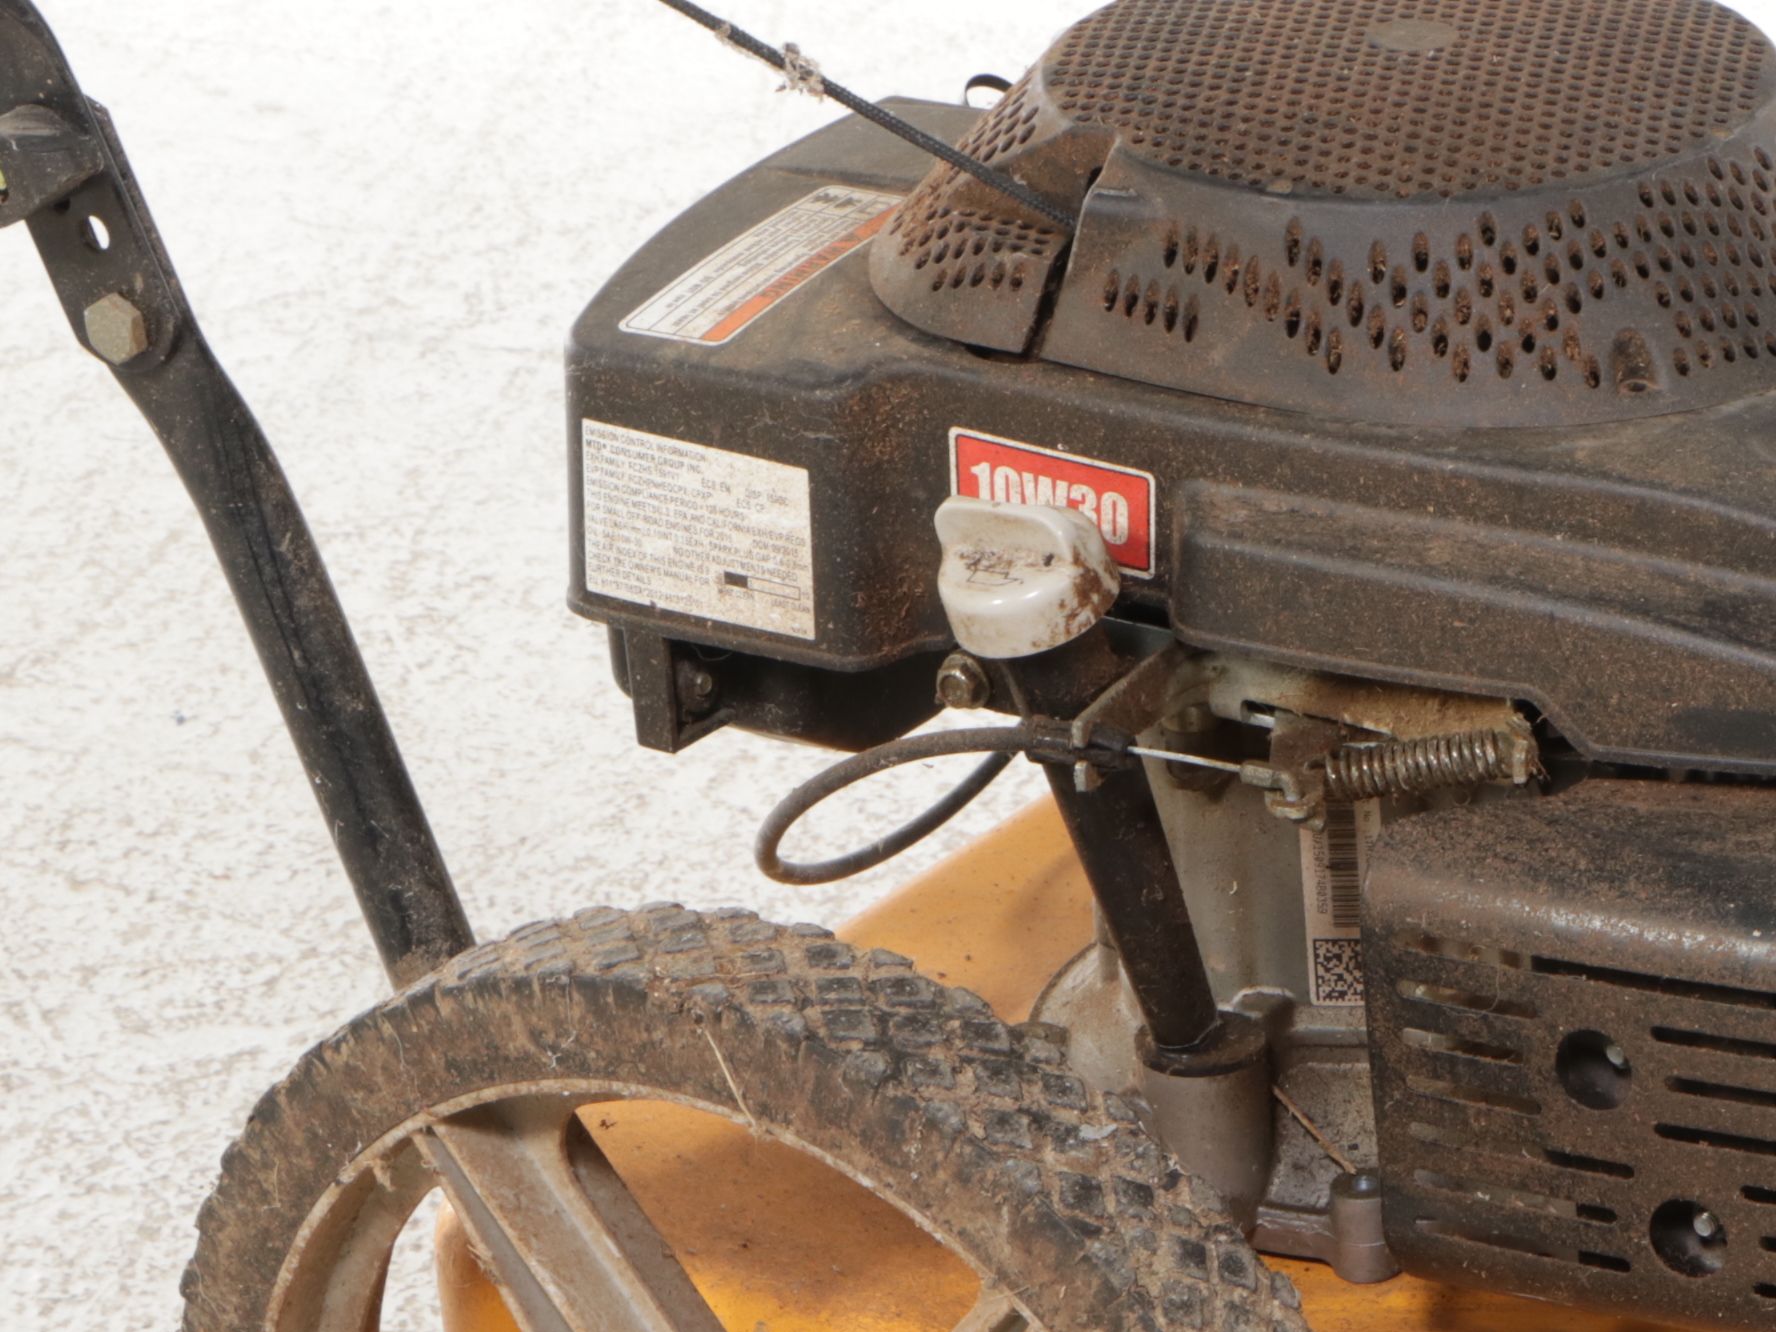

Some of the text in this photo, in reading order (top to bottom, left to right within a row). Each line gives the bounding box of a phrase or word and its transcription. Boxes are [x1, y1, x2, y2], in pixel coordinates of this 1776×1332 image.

[585, 426, 705, 462] EMISSION CONTROL INFORMATION
[610, 444, 655, 464] CONSUMER
[657, 455, 684, 470] GROUP
[970, 461, 1130, 546] 10W30
